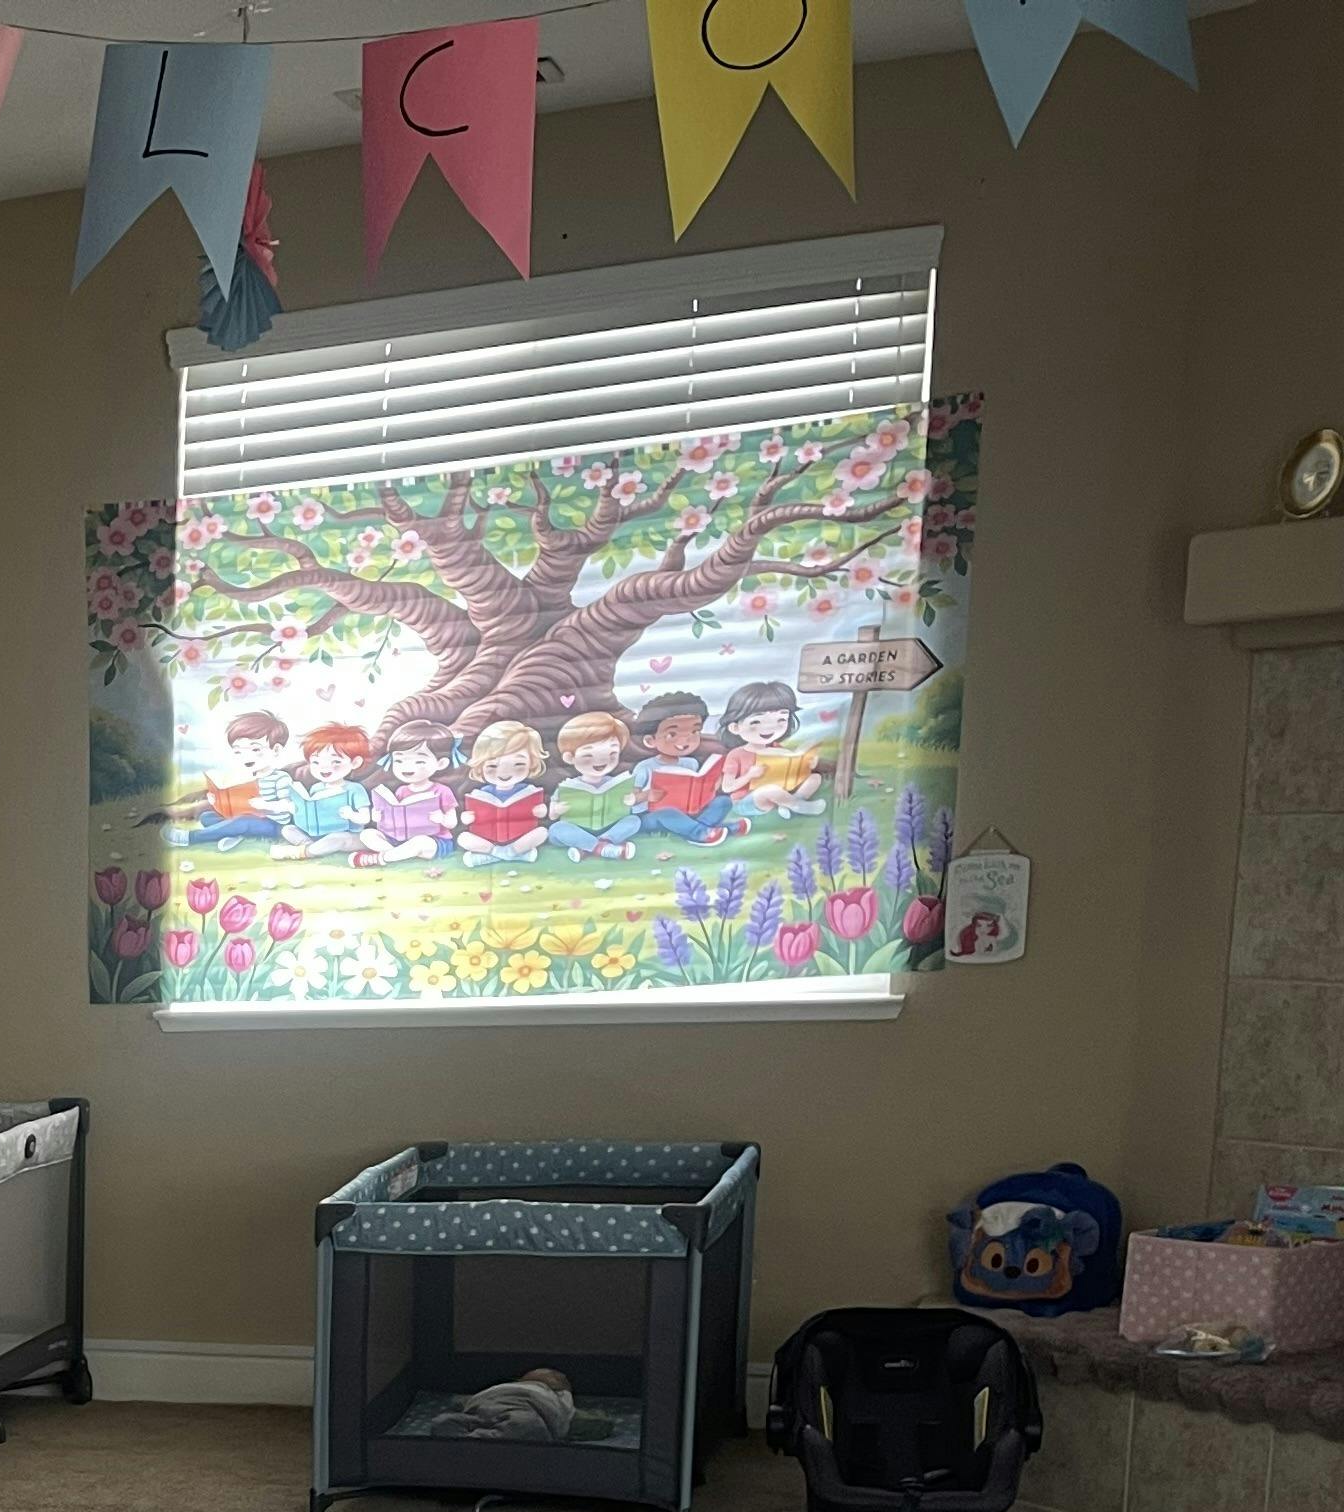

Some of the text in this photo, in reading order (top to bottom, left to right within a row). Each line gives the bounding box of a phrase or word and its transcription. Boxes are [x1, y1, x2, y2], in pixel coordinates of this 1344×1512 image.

[822, 650, 898, 665] A GARDEN
[838, 671, 895, 684] STORIES
